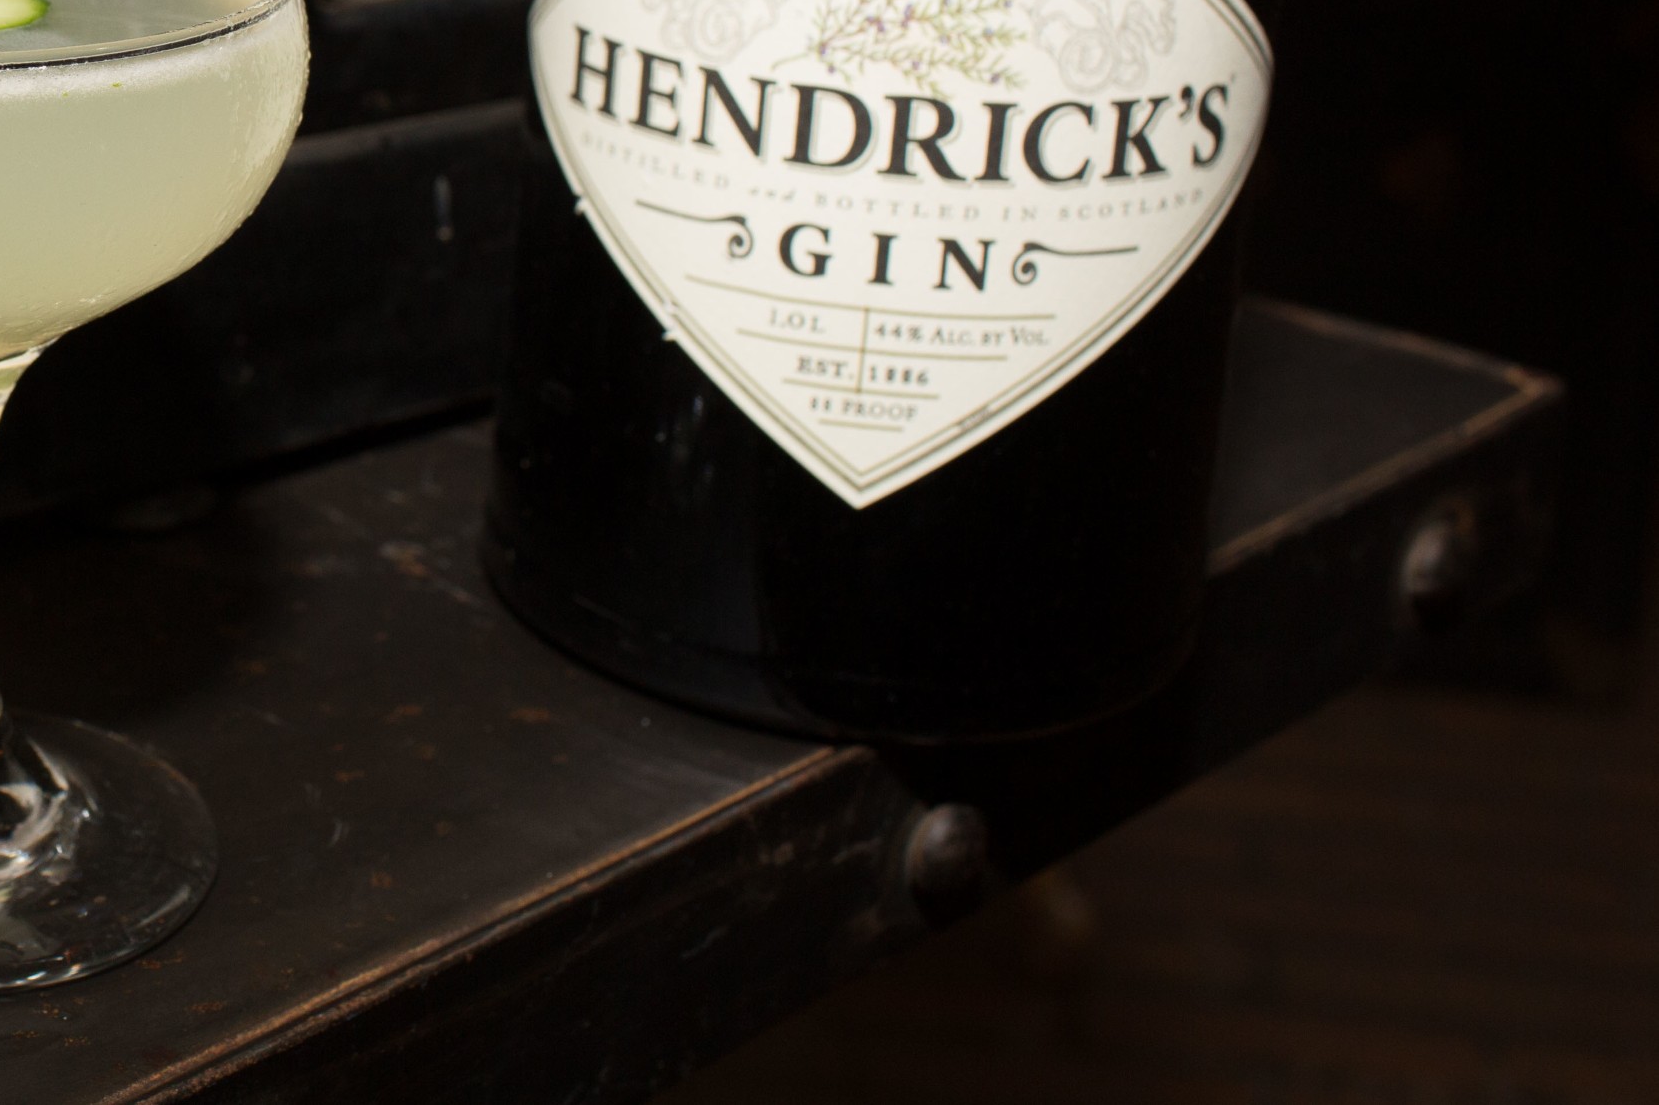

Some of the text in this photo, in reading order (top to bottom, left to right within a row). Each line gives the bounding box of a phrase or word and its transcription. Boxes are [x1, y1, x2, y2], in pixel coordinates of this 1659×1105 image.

[570, 25, 1229, 184] HENDRICK'S
[814, 192, 980, 221] BOTTLED
[1001, 205, 1038, 222] IN
[1057, 188, 1204, 222] SCOTLAND
[796, 355, 853, 381] EST.
[842, 400, 918, 421] PROOF
